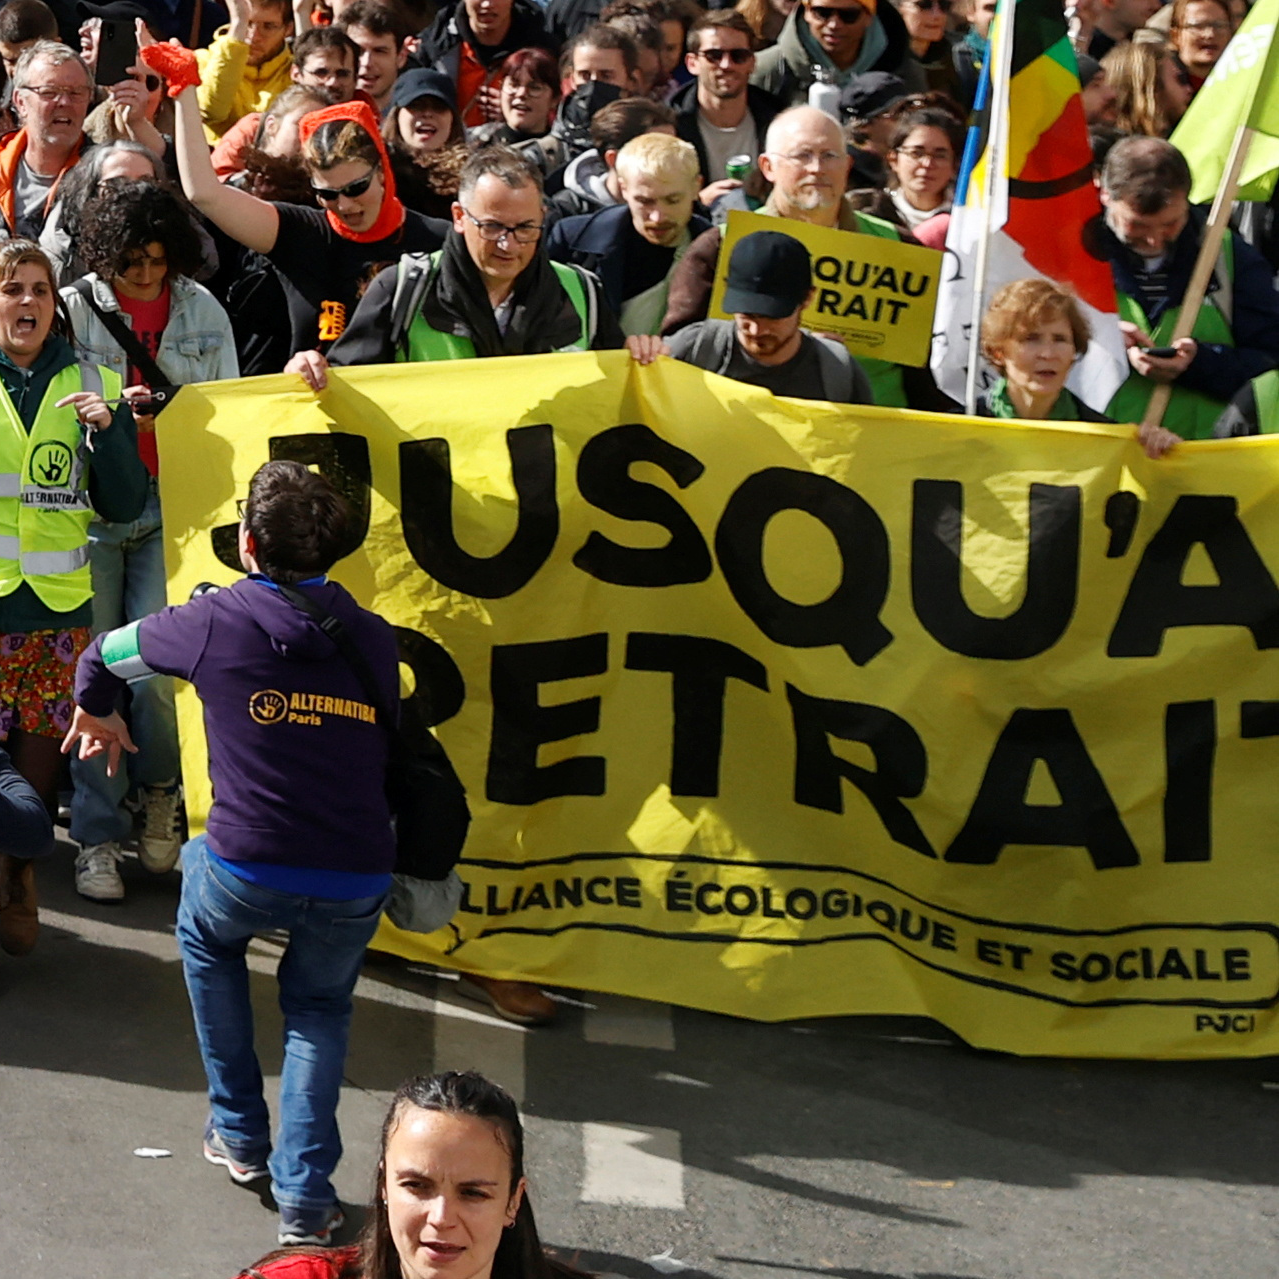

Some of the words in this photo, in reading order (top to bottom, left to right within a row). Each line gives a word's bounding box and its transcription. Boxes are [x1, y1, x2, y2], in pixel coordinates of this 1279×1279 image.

[288, 712, 322, 726] Paris
[290, 692, 376, 724] ALTERNATIBA
[458, 876, 642, 916] LLIANCE
[665, 869, 957, 954] ÉCOLOGIQUE
[976, 938, 1032, 971] ET
[1050, 947, 1251, 983] SOCIALE
